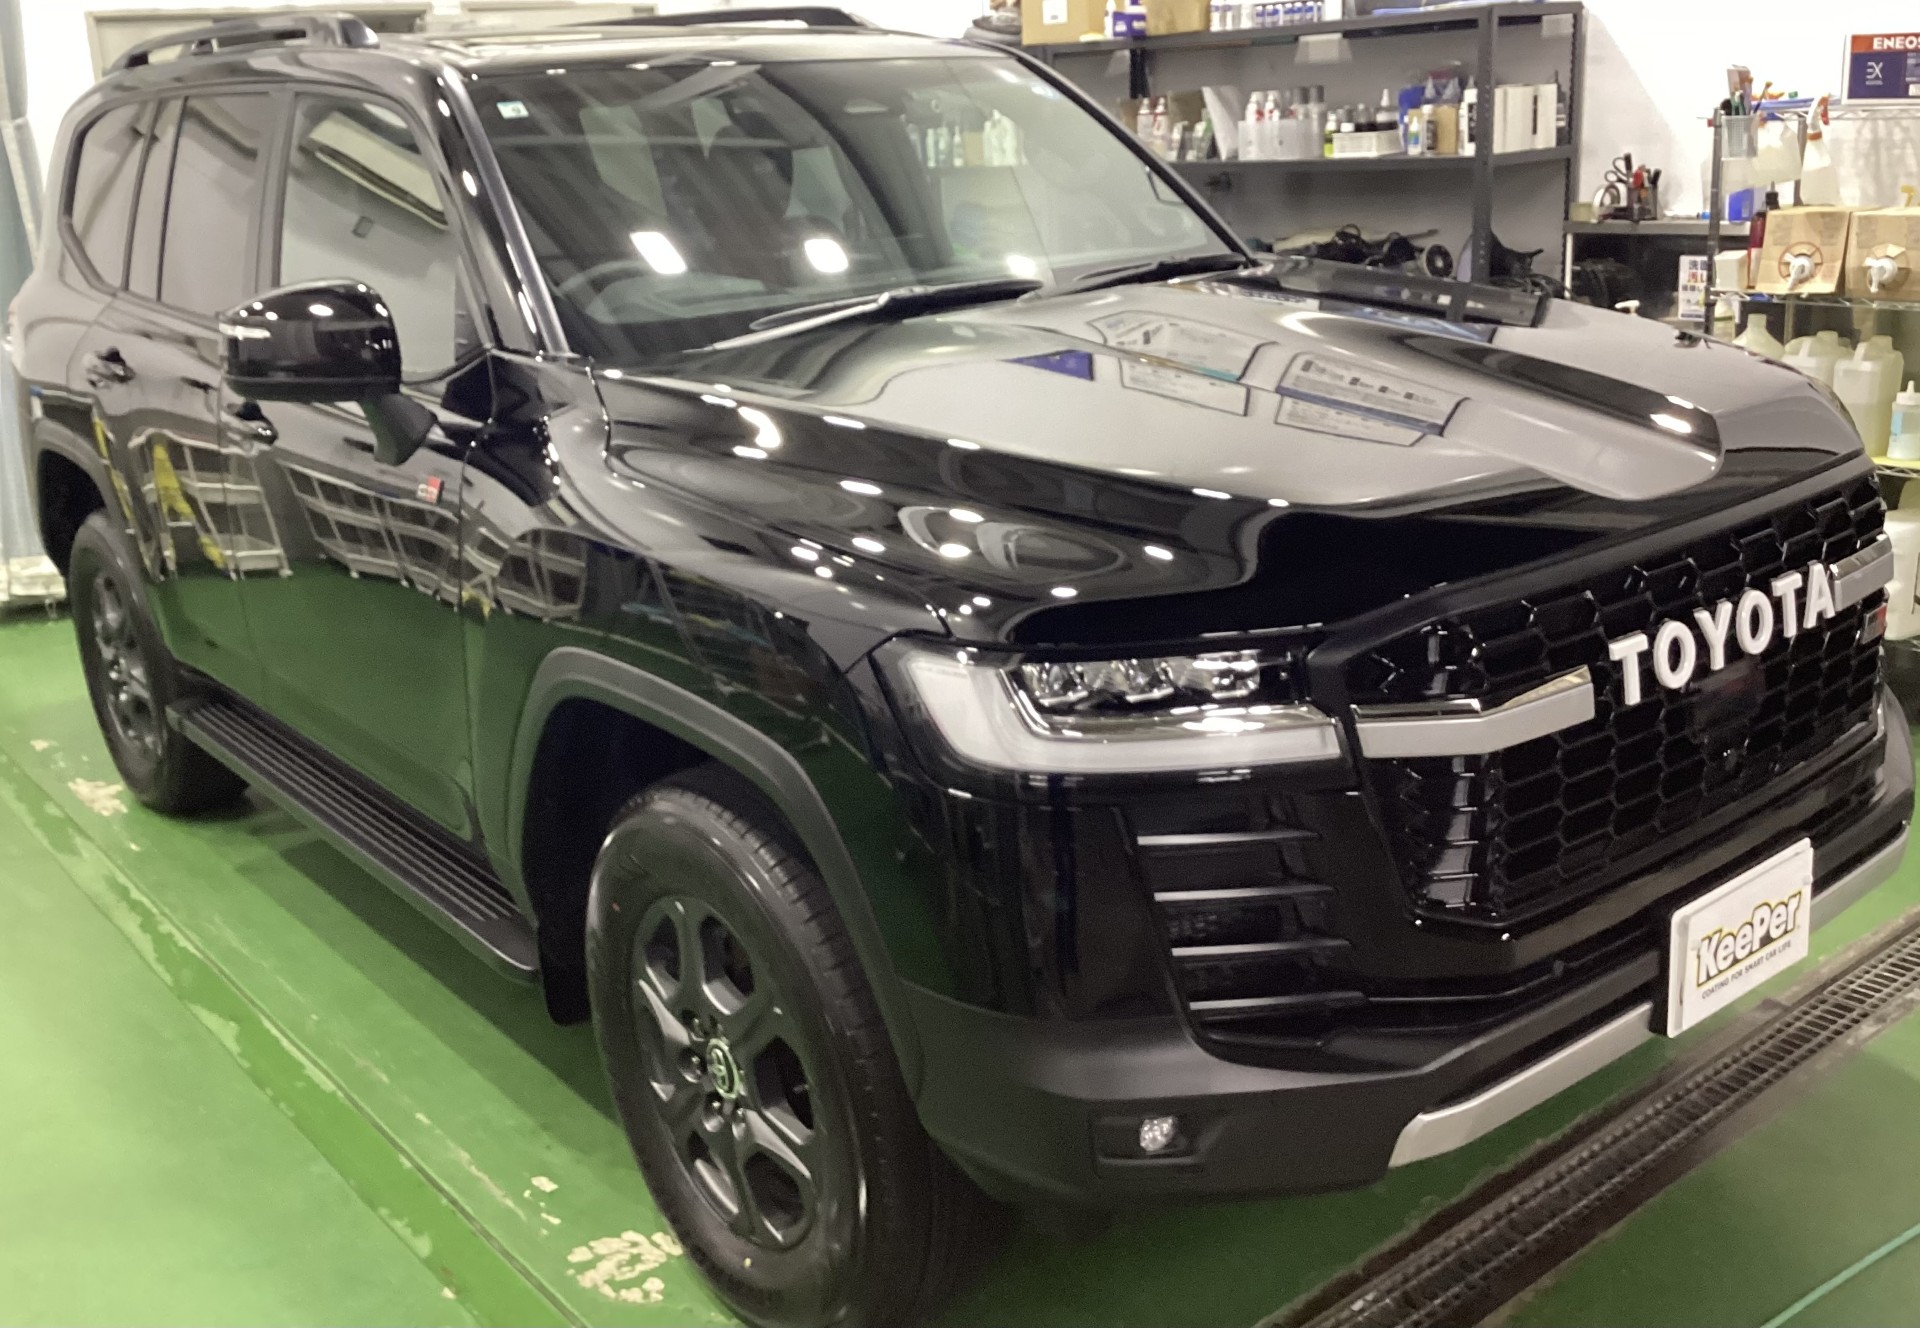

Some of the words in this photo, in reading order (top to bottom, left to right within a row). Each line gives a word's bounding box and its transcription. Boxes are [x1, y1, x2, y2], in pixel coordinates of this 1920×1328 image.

[1873, 36, 1920, 50] ENEO
[1608, 560, 1835, 706] TOYOTA
[1697, 891, 1801, 987] KeePer
[1702, 977, 1729, 999] COATING
[1731, 969, 1743, 982] FOR
[1745, 955, 1764, 973] SMART
[1765, 949, 1776, 961] CAR
[1778, 939, 1791, 953] LIFE
